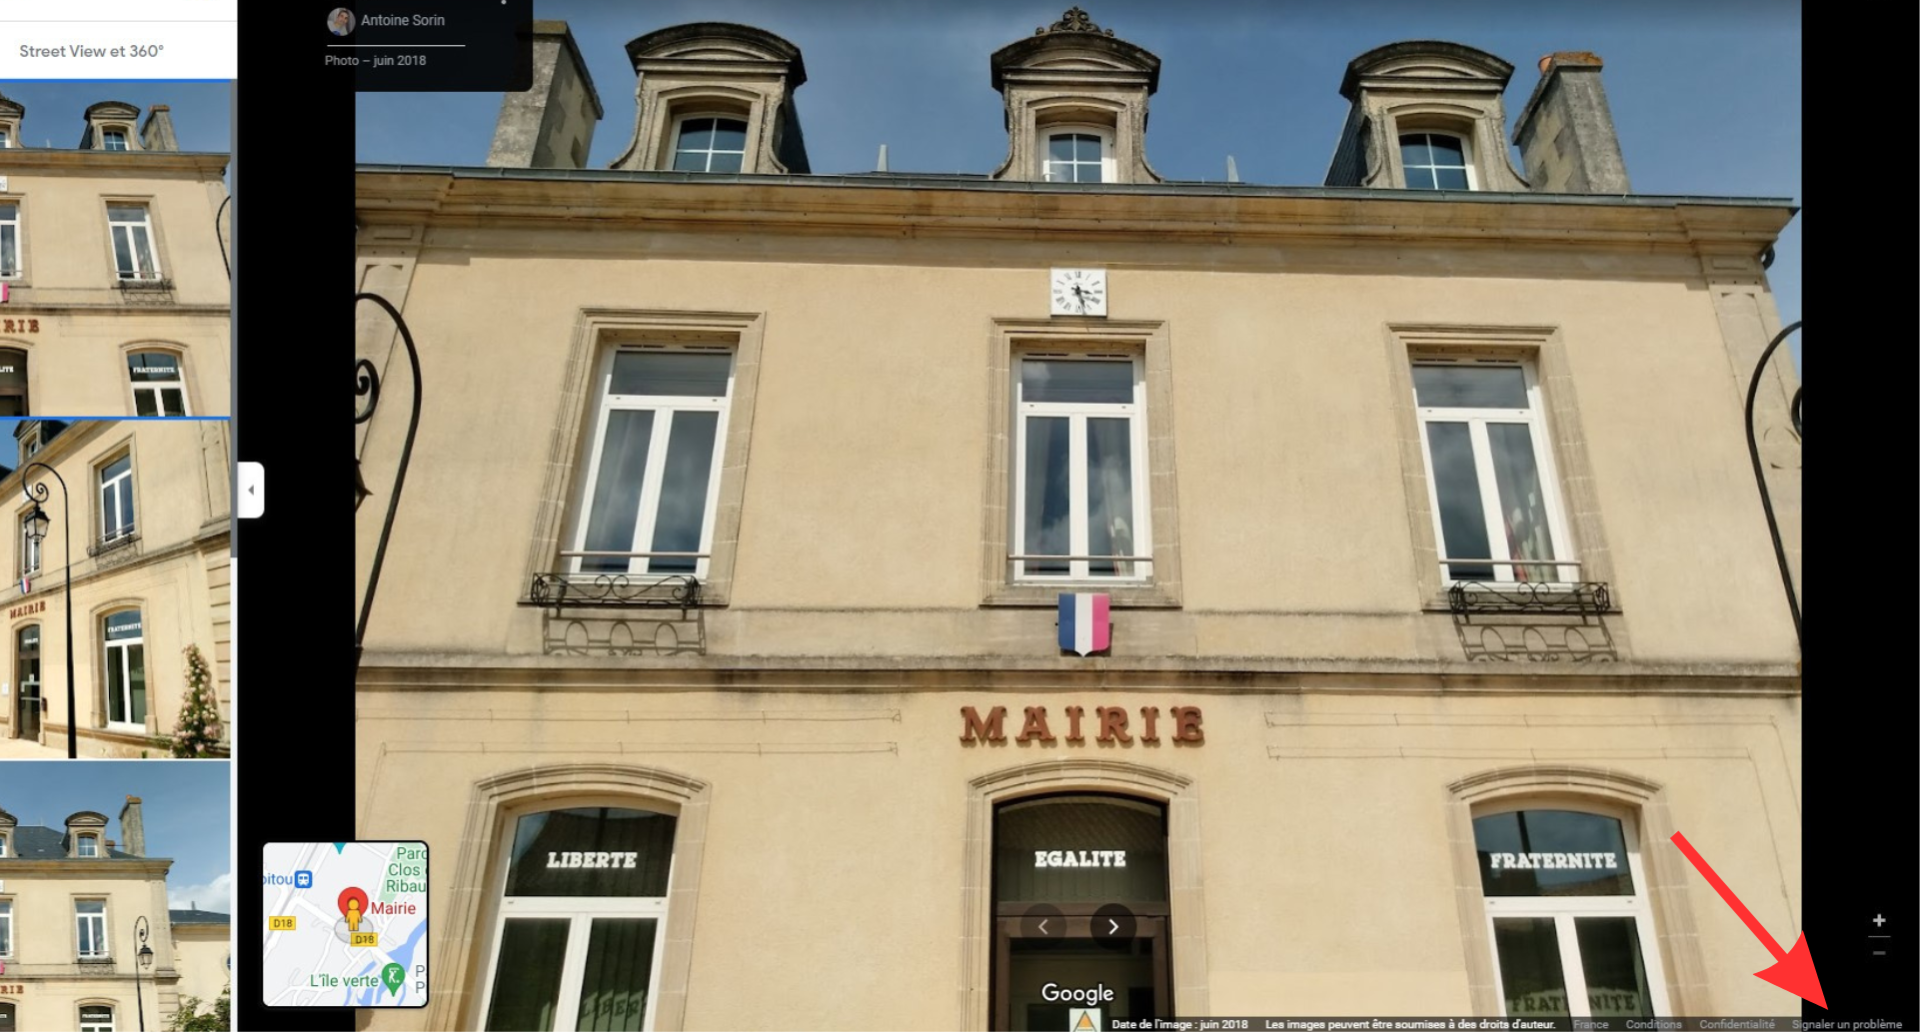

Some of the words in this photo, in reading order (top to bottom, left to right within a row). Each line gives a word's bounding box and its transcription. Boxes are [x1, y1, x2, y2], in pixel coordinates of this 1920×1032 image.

[959, 705, 1206, 744] MAIRIE
[546, 851, 638, 869] LIBERTE
[1034, 850, 1126, 868] EGALITE
[1489, 852, 1618, 869] FRATERNITE
